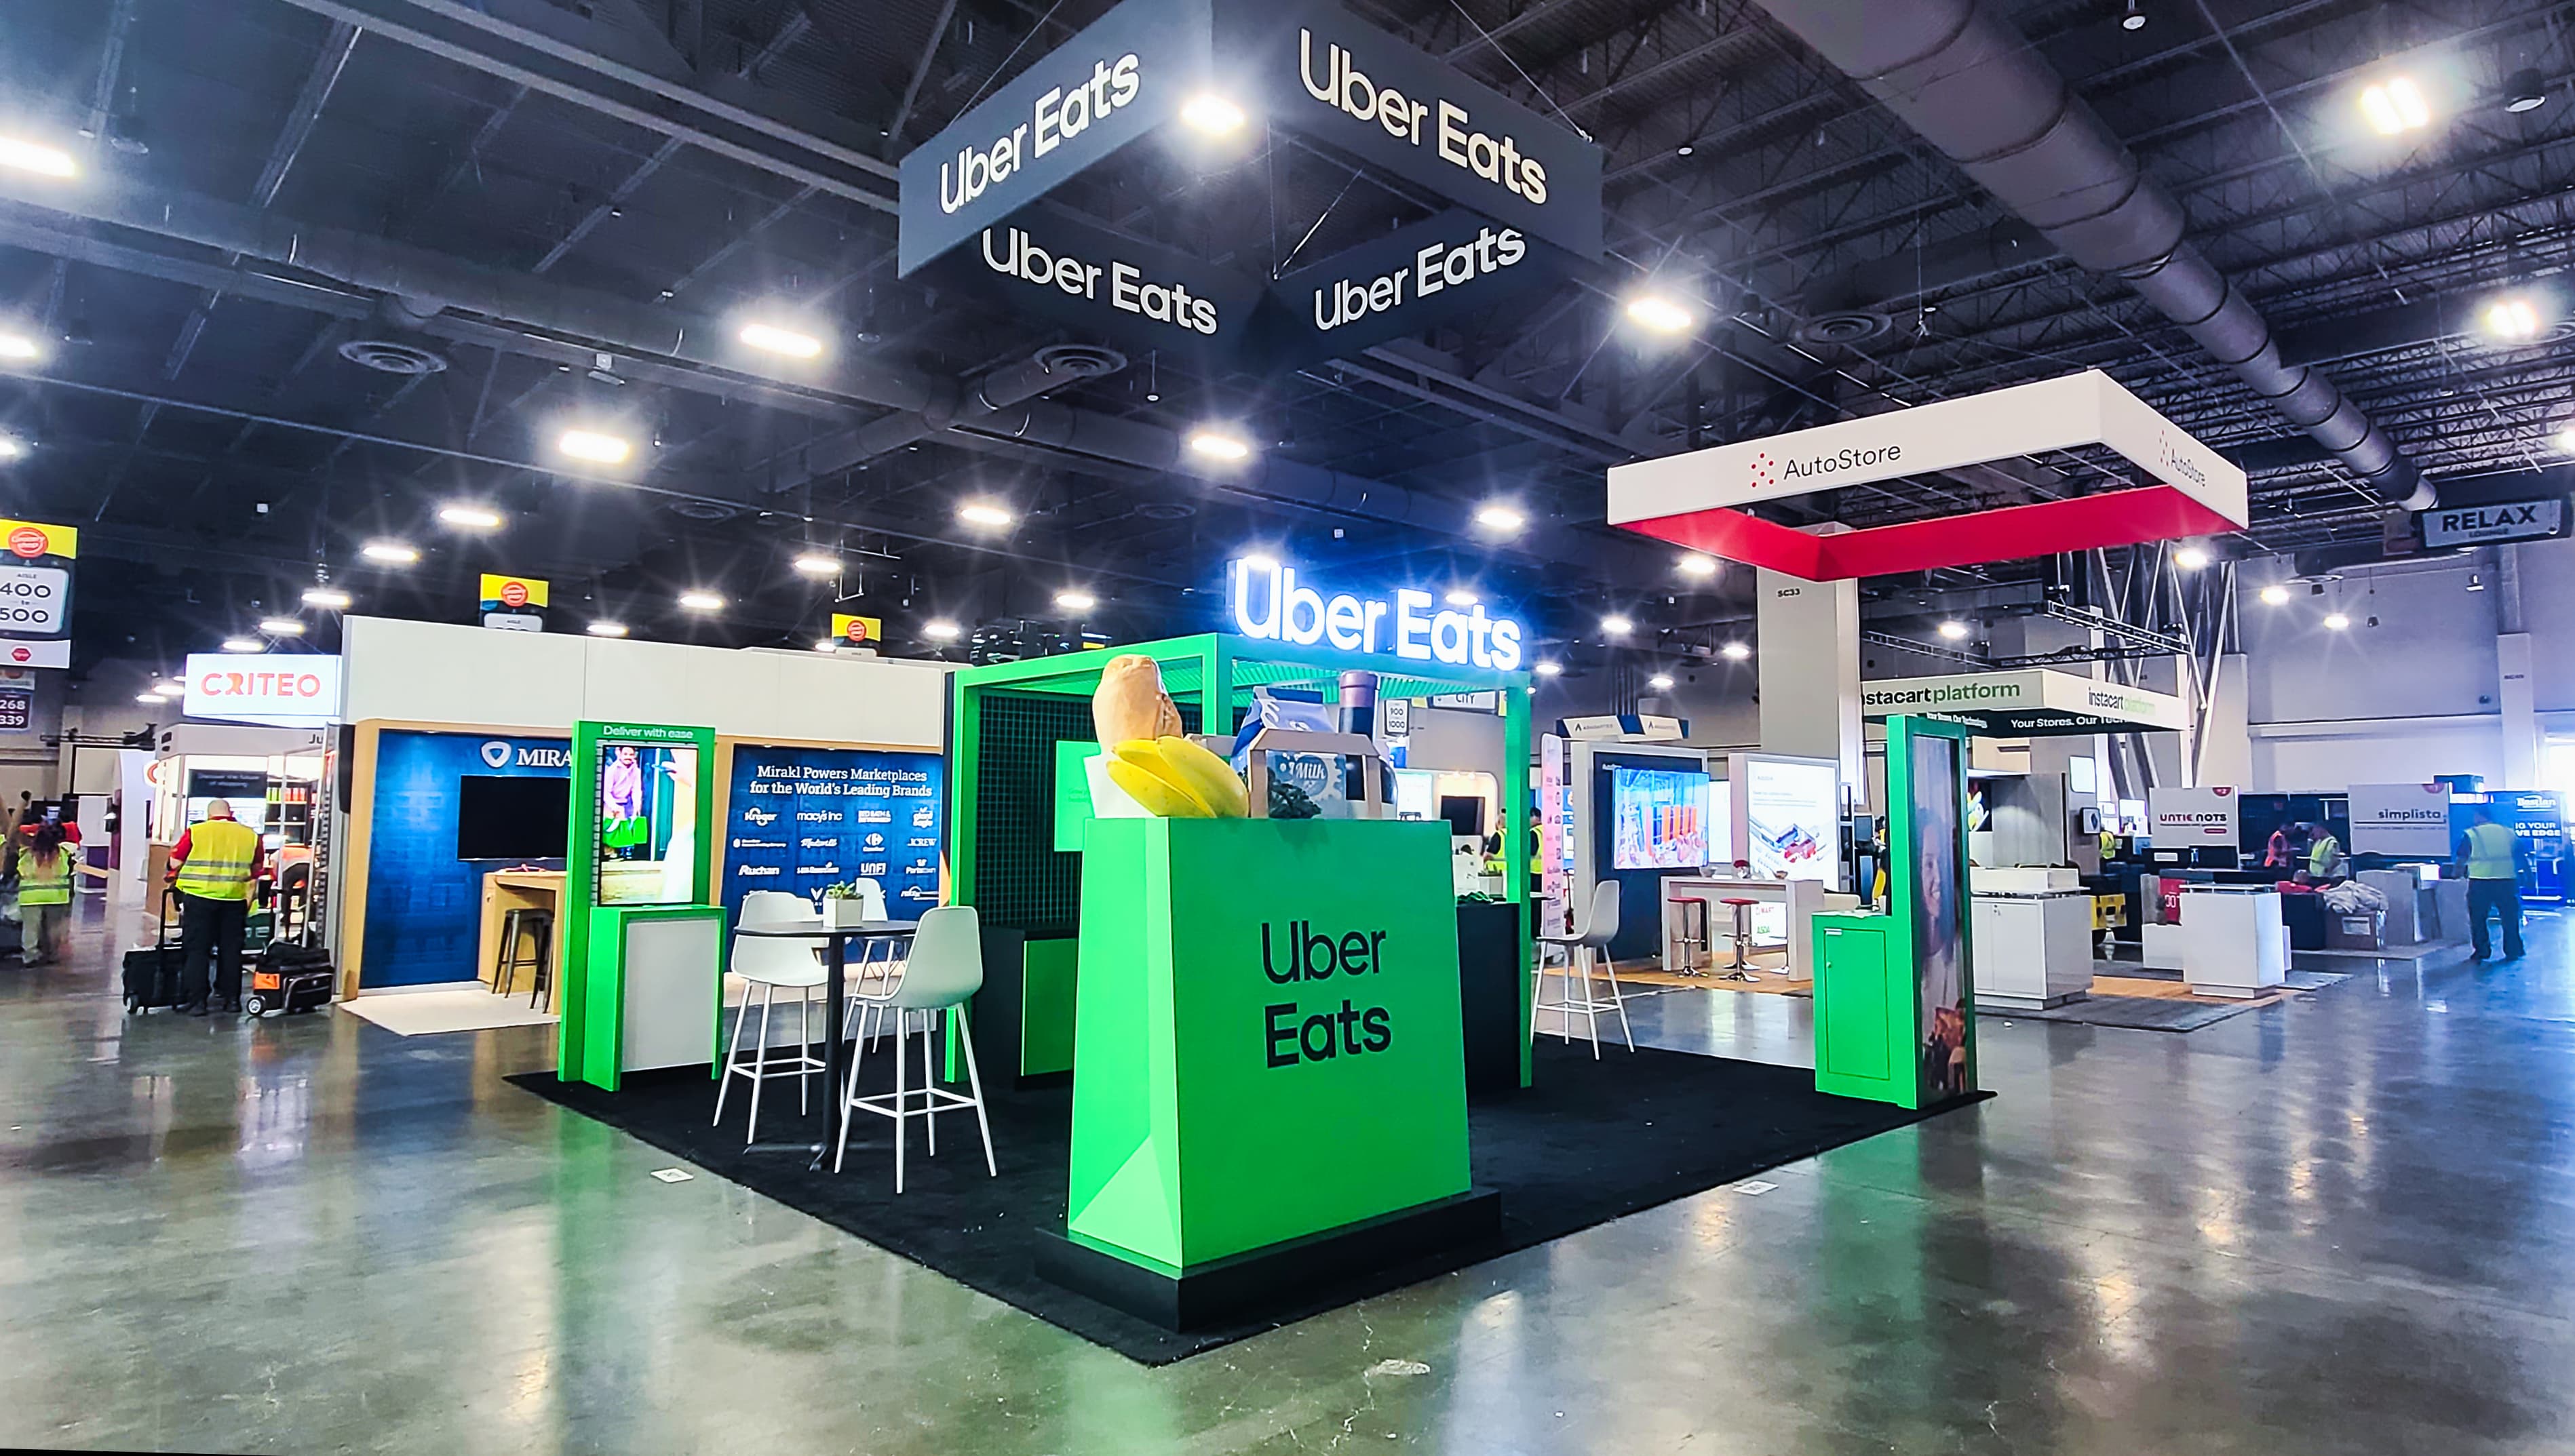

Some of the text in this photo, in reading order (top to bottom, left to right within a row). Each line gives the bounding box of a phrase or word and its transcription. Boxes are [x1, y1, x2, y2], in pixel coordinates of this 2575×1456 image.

[1300, 28, 1547, 205] Uber Eats
[939, 53, 1140, 214] Uber Eats
[982, 228, 1218, 335] Uber Eats
[1314, 226, 1526, 331] Uber Eats
[1783, 445, 1901, 480] AutoStore
[2171, 448, 2206, 488] AutoStore
[2442, 505, 2537, 532] RELAX
[0, 583, 52, 598] 400
[1233, 557, 1524, 671] Uber Eats
[201, 672, 321, 697] CRITEO
[1861, 683, 2020, 705] stacart platform
[1456, 694, 1475, 704] CITY
[2089, 686, 2124, 710] instacart
[603, 726, 642, 736] Deliver
[644, 728, 666, 737] with
[2011, 719, 2034, 728] Your
[2037, 717, 2074, 727] Stores.
[2076, 716, 2097, 725] Our
[757, 766, 927, 783] Mirakl Powers Marketplaces
[1296, 762, 1326, 779] Milk
[750, 781, 932, 798] for the World's Leading Brands
[745, 808, 777, 826] Kroger
[2378, 809, 2441, 821] simplista
[1261, 920, 1386, 984] Uber
[1264, 998, 1391, 1069] Eats
